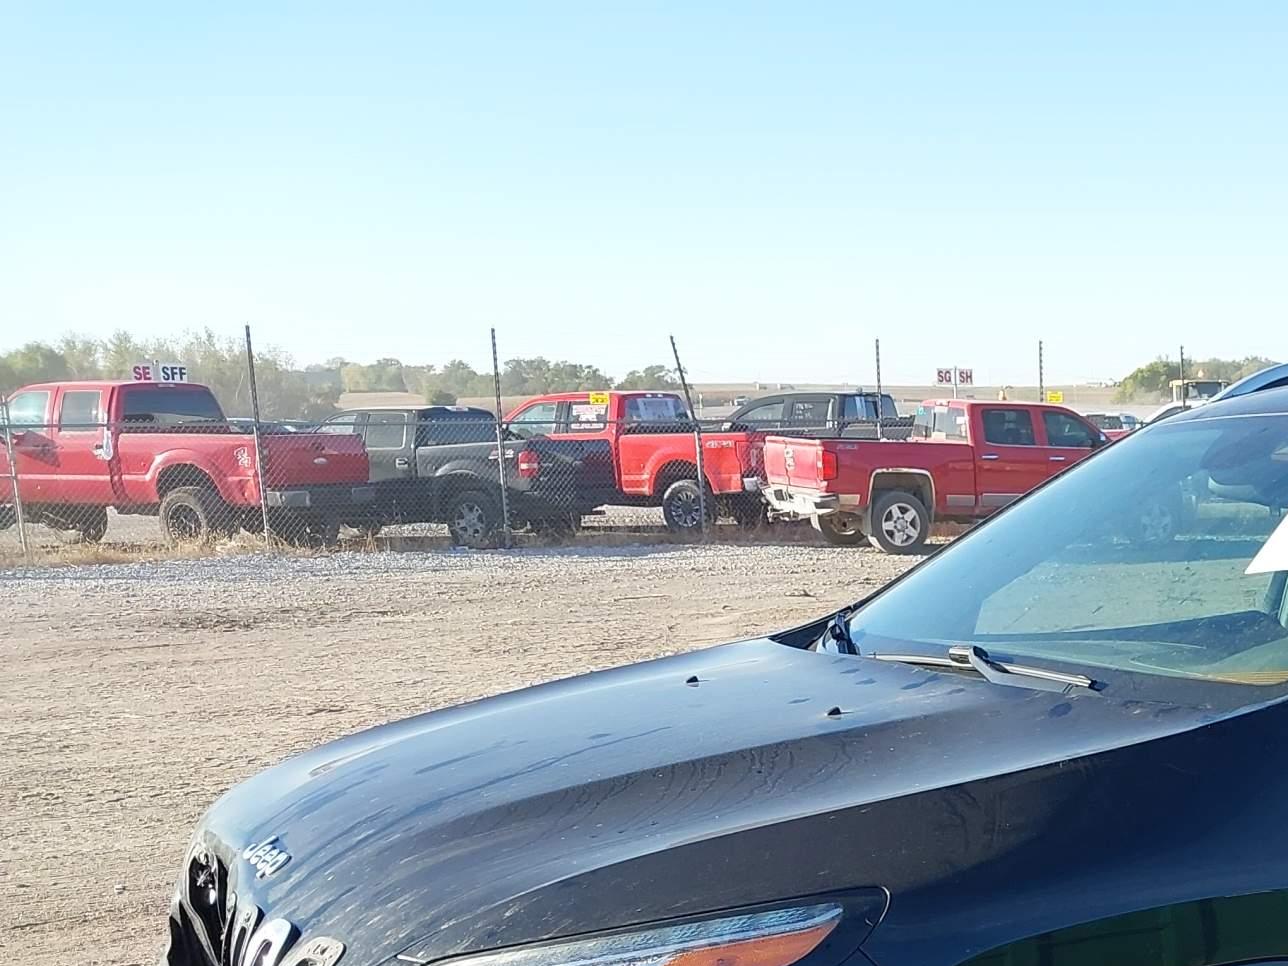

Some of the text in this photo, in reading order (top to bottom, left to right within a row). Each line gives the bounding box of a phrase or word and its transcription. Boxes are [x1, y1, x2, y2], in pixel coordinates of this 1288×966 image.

[133, 366, 152, 381] SE
[161, 366, 187, 381] SFF
[937, 370, 952, 383] SG
[959, 370, 973, 384] SH
[243, 835, 289, 879] Jeep
